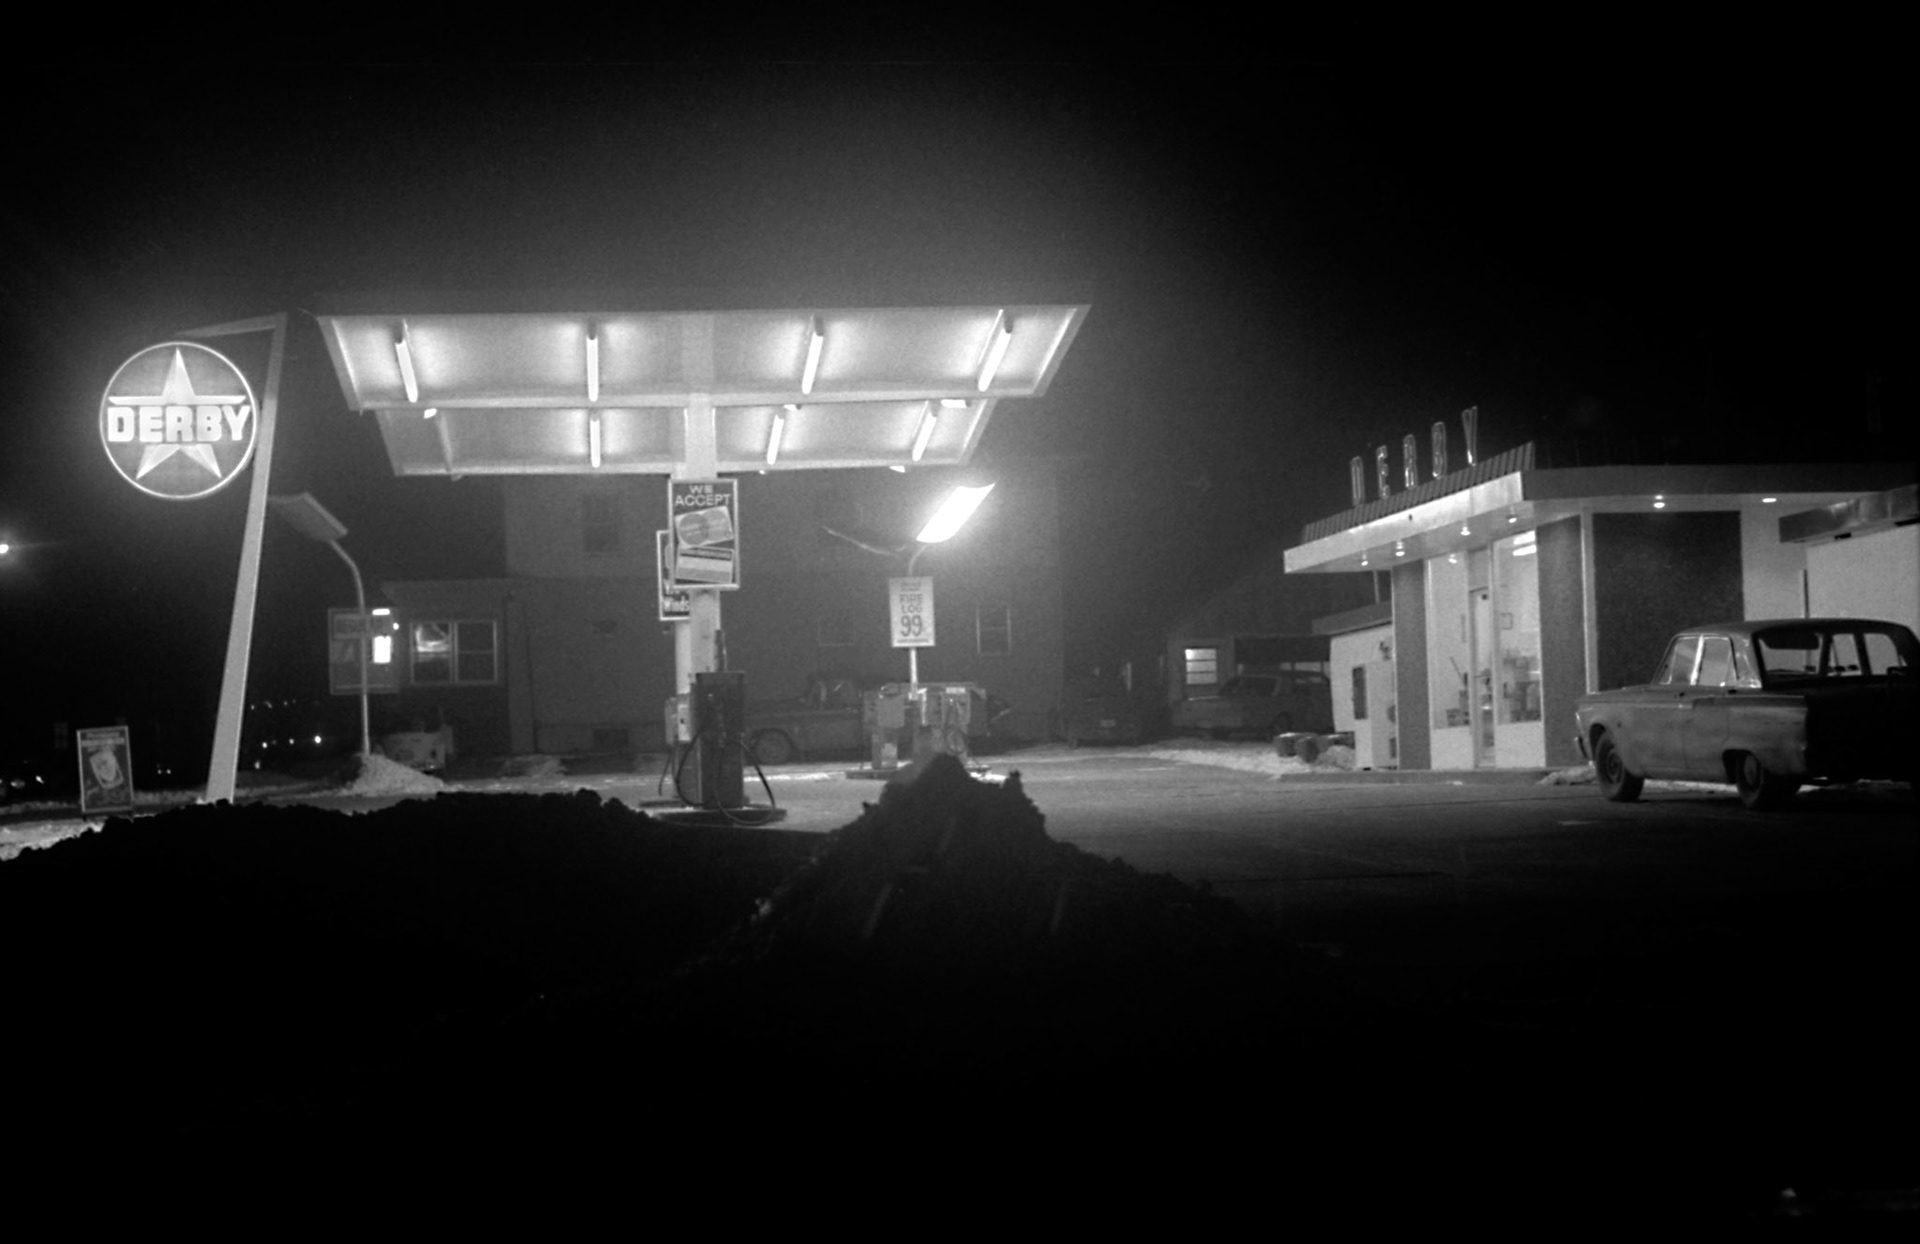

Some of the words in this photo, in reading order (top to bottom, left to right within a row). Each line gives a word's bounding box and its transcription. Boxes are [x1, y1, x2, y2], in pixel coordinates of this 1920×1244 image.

[107, 405, 251, 443] DERBY
[1350, 406, 1478, 505] DERBY
[674, 494, 731, 506] ACCEPT
[689, 485, 713, 493] WE
[900, 614, 922, 637] 99
